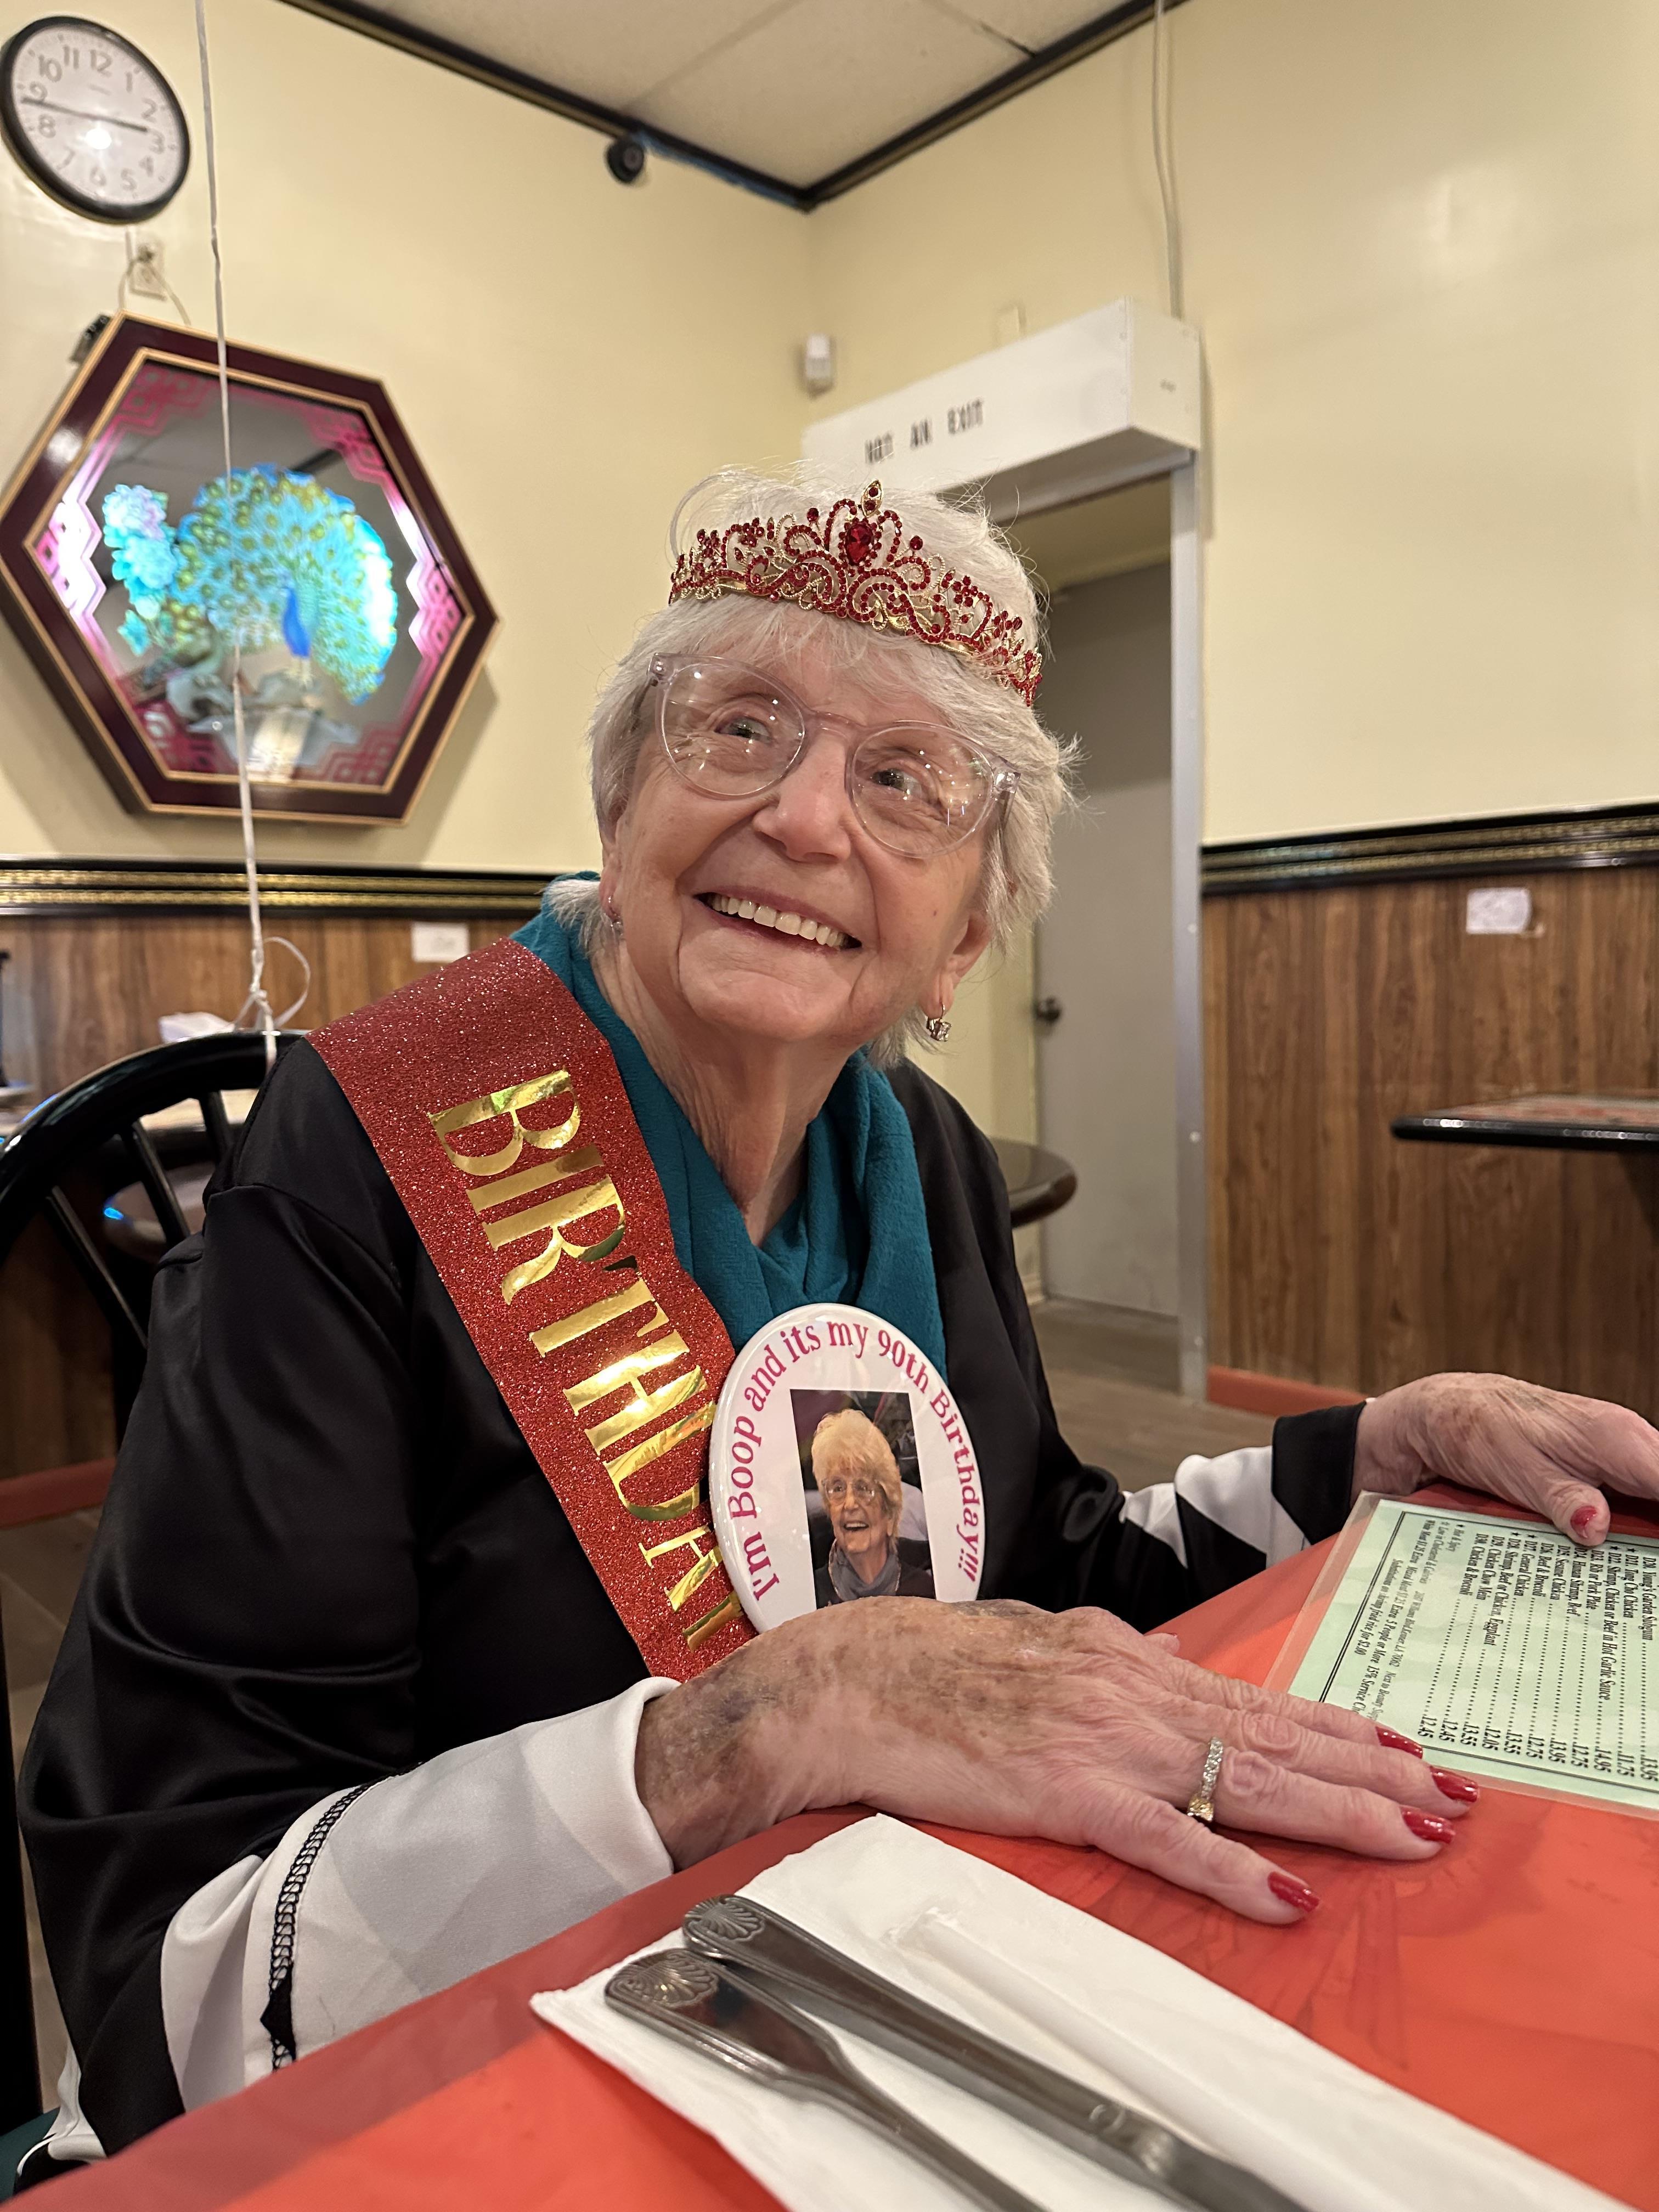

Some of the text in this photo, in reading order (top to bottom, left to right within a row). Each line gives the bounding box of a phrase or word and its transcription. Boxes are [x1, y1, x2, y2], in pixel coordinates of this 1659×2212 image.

[39, 54, 63, 82] 10
[63, 45, 80, 70] 11
[90, 49, 112, 77] 12
[126, 72, 133, 93] 1
[142, 98, 157, 122] 2
[38, 114, 56, 138] 8
[149, 129, 164, 154] 3
[57, 145, 76, 170] 7
[139, 156, 154, 177] 4
[90, 166, 106, 187] 6
[121, 168, 137, 191] 5
[910, 417, 933, 450] AN
[948, 398, 984, 434] EXIT
[728, 1321, 980, 1600] I'm Boop and its my 90th Birthday!!!
[1468, 1546, 1486, 1566] Chicken
[1484, 1548, 1502, 1569] Chicken
[1498, 1550, 1519, 1571] Shrimp,
[1519, 1553, 1536, 1575] General
[1537, 1555, 1553, 1568] Beef
[1481, 1570, 1497, 1584] Chow
[1498, 1571, 1514, 1585] Beef
[1553, 1558, 1570, 1577] Sesame
[1571, 1560, 1587, 1578] Hunan
[1589, 1563, 1604, 1573] Rib
[1602, 1565, 1621, 1587] Shrimp,
[1621, 1568, 1639, 1582] Tong
[1459, 1573, 1478, 1596] Broccoli
[1514, 1574, 1531, 1596] Chicken
[1532, 1574, 1549, 1597] Broccoli
[1550, 1578, 1567, 1600] Chicken
[1565, 1578, 1584, 1601] Shrimp,
[1587, 1580, 1602, 1594] Pork
[1624, 1582, 1639, 1594] Cho
[1639, 1571, 1657, 1592] Young's
[1476, 1587, 1493, 1600] Mein
[1585, 1595, 1601, 1610] Plate
[1605, 1588, 1620, 1611] Chicken
[1642, 1593, 1657, 1615] Garden
[1368, 1607, 1384, 1622] fried
[1388, 1604, 1403, 1618] Extra
[1566, 1602, 1582, 1617] Beef
[1623, 1595, 1638, 1618] Chicken
[1359, 1629, 1374, 1640] for
[1364, 1621, 1378, 1631] rice
[1378, 1623, 1396, 1641] People
[1482, 1618, 1504, 1646] Eggplant
[1603, 1619, 1619, 1635] Beef
[1638, 1615, 1657, 1641] Subgum
[1354, 1640, 1371, 1655] $2.00
[1370, 1650, 1386, 1663] More
[1394, 1644, 1405, 1652] LA
[1601, 1642, 1618, 1655] Hot
[1389, 1654, 1403, 1667] 70062
[1600, 1656, 1617, 1678] Garlic
[1364, 1665, 1380, 1679] 15%
[1383, 1671, 1396, 1683] Next
[1356, 1679, 1375, 1701] Service
[1372, 1689, 1390, 1708] Beauty
[1598, 1679, 1616, 1700] Sauce
[1417, 1716, 1437, 1739] 12.45
[1438, 1720, 1458, 1742] 12.45
[1460, 1724, 1480, 1747] 13.55
[1482, 1728, 1501, 1751] 12.05
[1504, 1732, 1522, 1755] 13.55
[1526, 1736, 1545, 1759] 12.75
[1548, 1740, 1567, 1764] 13.95
[1571, 1744, 1589, 1768] 12.75
[1593, 1748, 1612, 1773] 14.95
[1617, 1752, 1635, 1778] 11.75
[1640, 1756, 1658, 1782] 13.95
